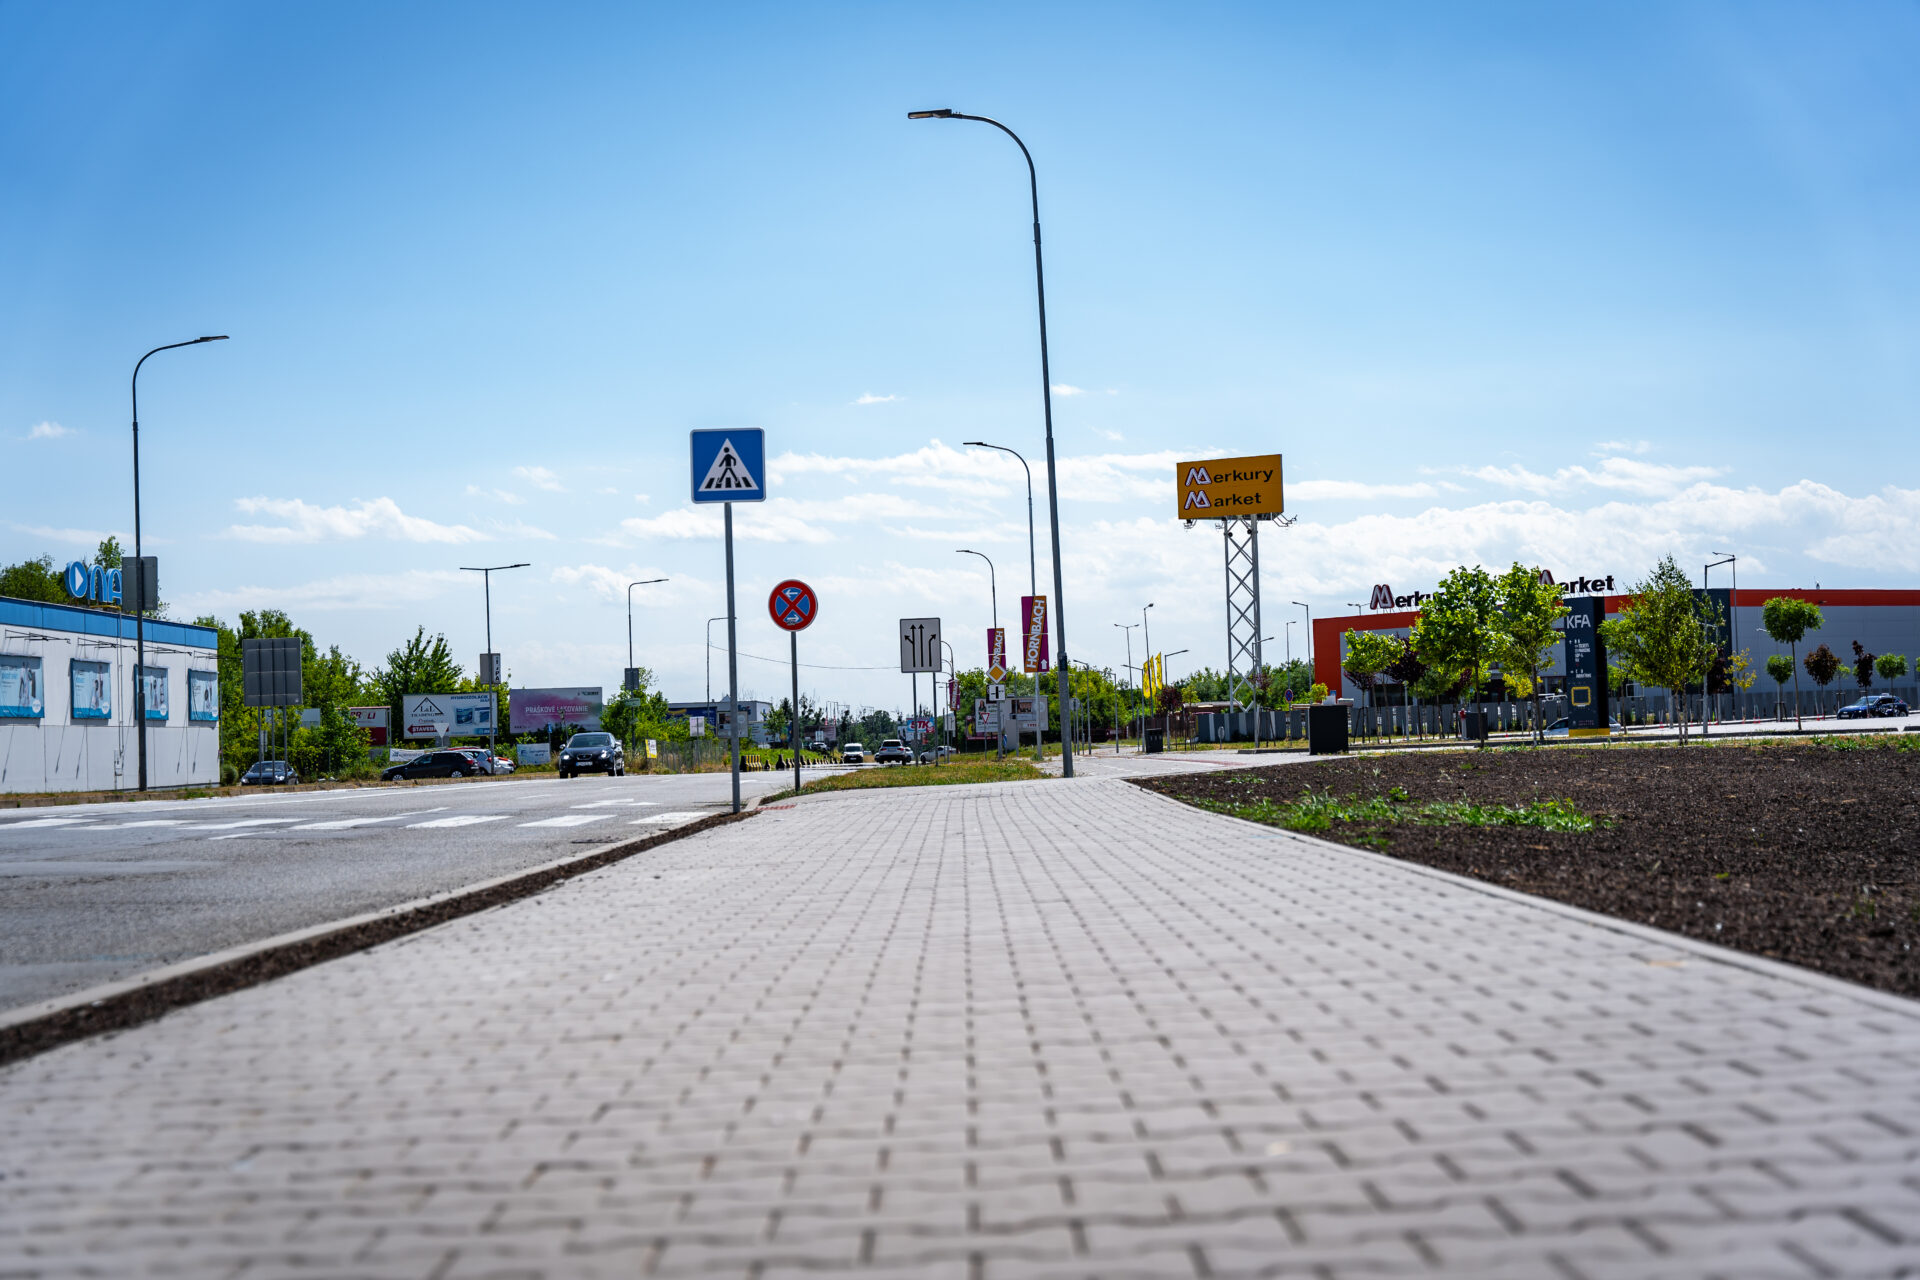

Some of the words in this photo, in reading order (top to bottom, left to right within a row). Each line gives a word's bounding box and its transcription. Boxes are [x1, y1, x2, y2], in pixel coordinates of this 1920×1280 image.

[1185, 466, 1273, 488] Merkury
[1184, 490, 1261, 511] Market
[1566, 614, 1591, 629] KFA
[1026, 599, 1046, 669] HORNBACH
[992, 631, 1004, 665] RNBACH
[910, 720, 931, 729] STK
